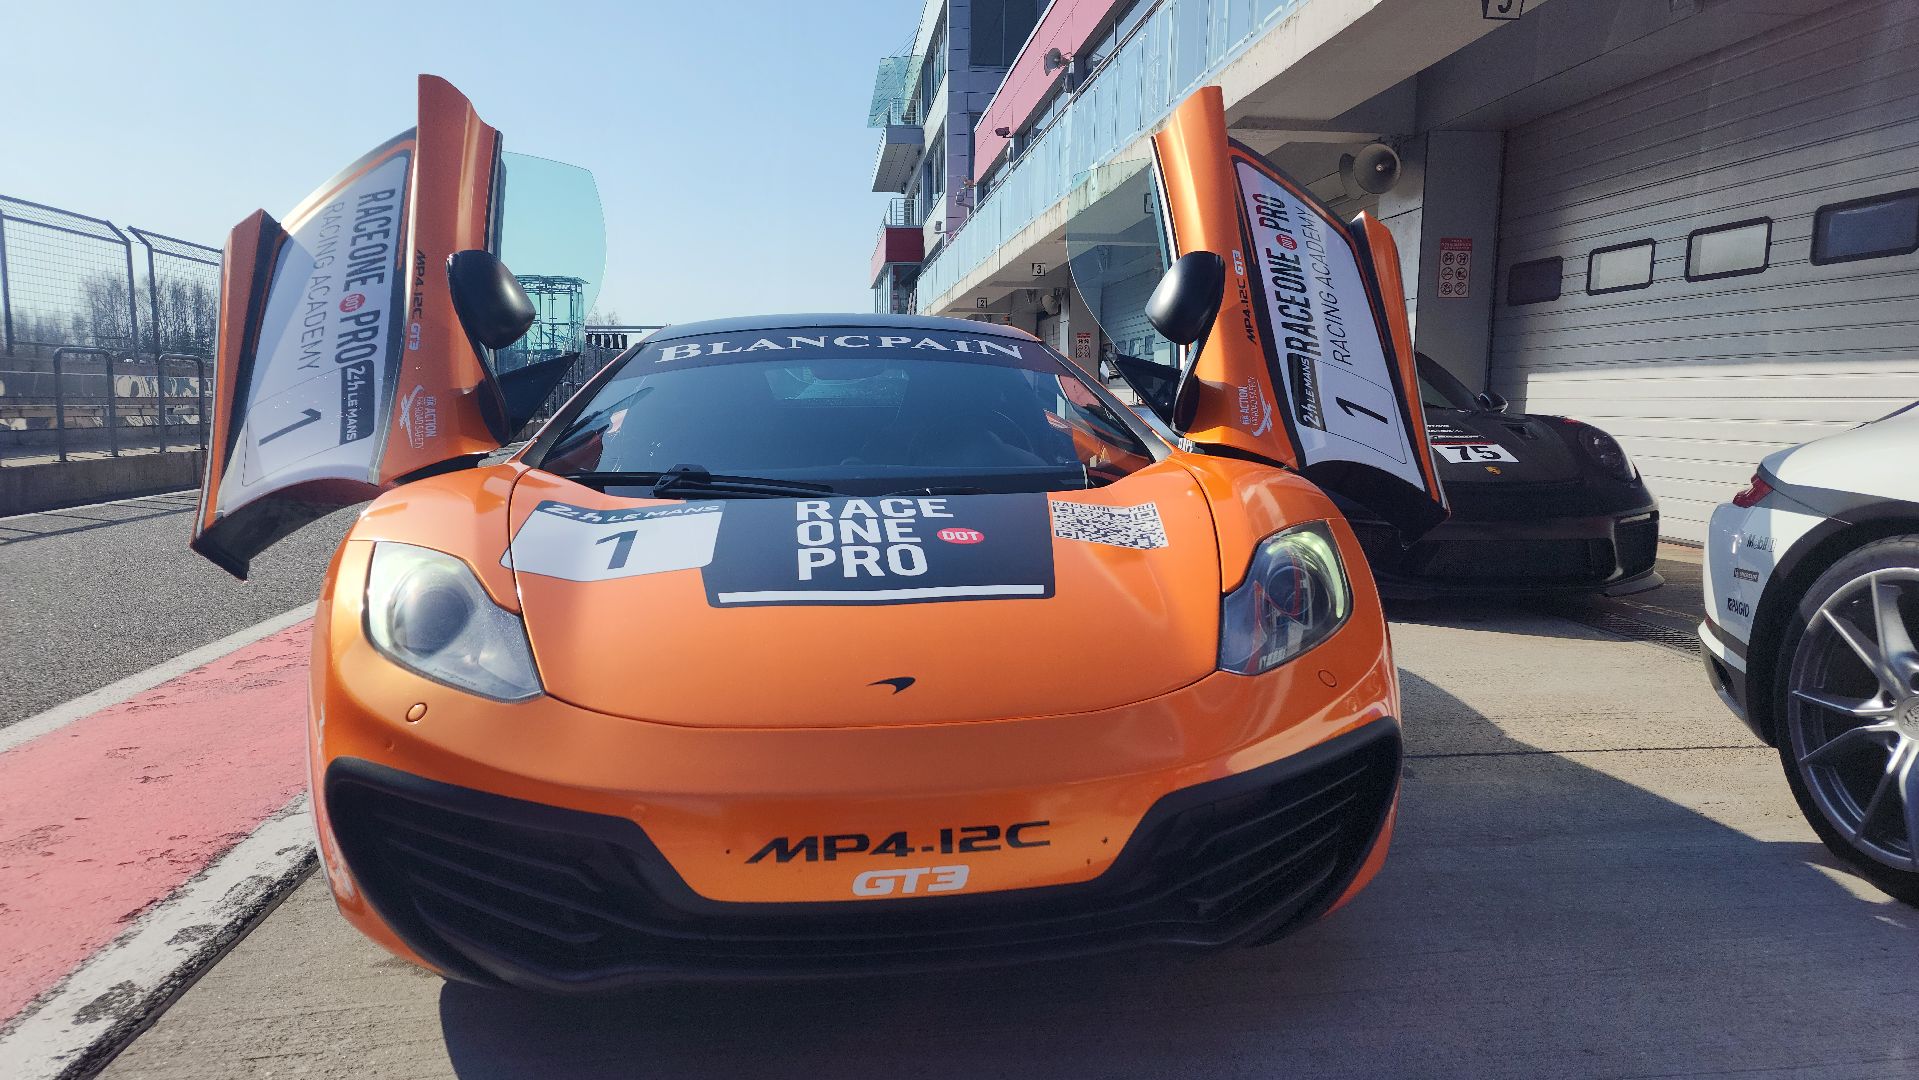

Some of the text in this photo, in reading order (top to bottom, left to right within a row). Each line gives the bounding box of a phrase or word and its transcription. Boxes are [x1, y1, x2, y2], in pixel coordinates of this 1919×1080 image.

[1252, 193, 1293, 234] PRO
[297, 202, 344, 371] RACING ACADEMY
[1232, 249, 1257, 345] MP4-12C GT3
[1295, 206, 1353, 366] RACING ACADEMY
[334, 310, 381, 364] PRO
[408, 321, 422, 351] GT3
[655, 334, 1023, 362] BLANCPAIN
[1300, 356, 1313, 387] MANS
[347, 393, 360, 408] LE
[1237, 386, 1249, 414] ACTION
[1304, 387, 1315, 403] LE
[345, 408, 361, 441] MANS
[425, 407, 437, 437] ACTION
[1336, 397, 1388, 424] 1
[259, 408, 321, 446] 1
[415, 425, 424, 449] SAFETY
[1445, 446, 1501, 460] 75
[606, 513, 641, 522] LE
[644, 505, 720, 518] MANS
[796, 498, 954, 521] RACE
[796, 518, 922, 546] ONE
[941, 530, 980, 541] DOT
[595, 529, 638, 570] 1
[798, 543, 928, 581] PRO
[744, 820, 1050, 864] MP4-12C
[852, 864, 970, 897] GT3
